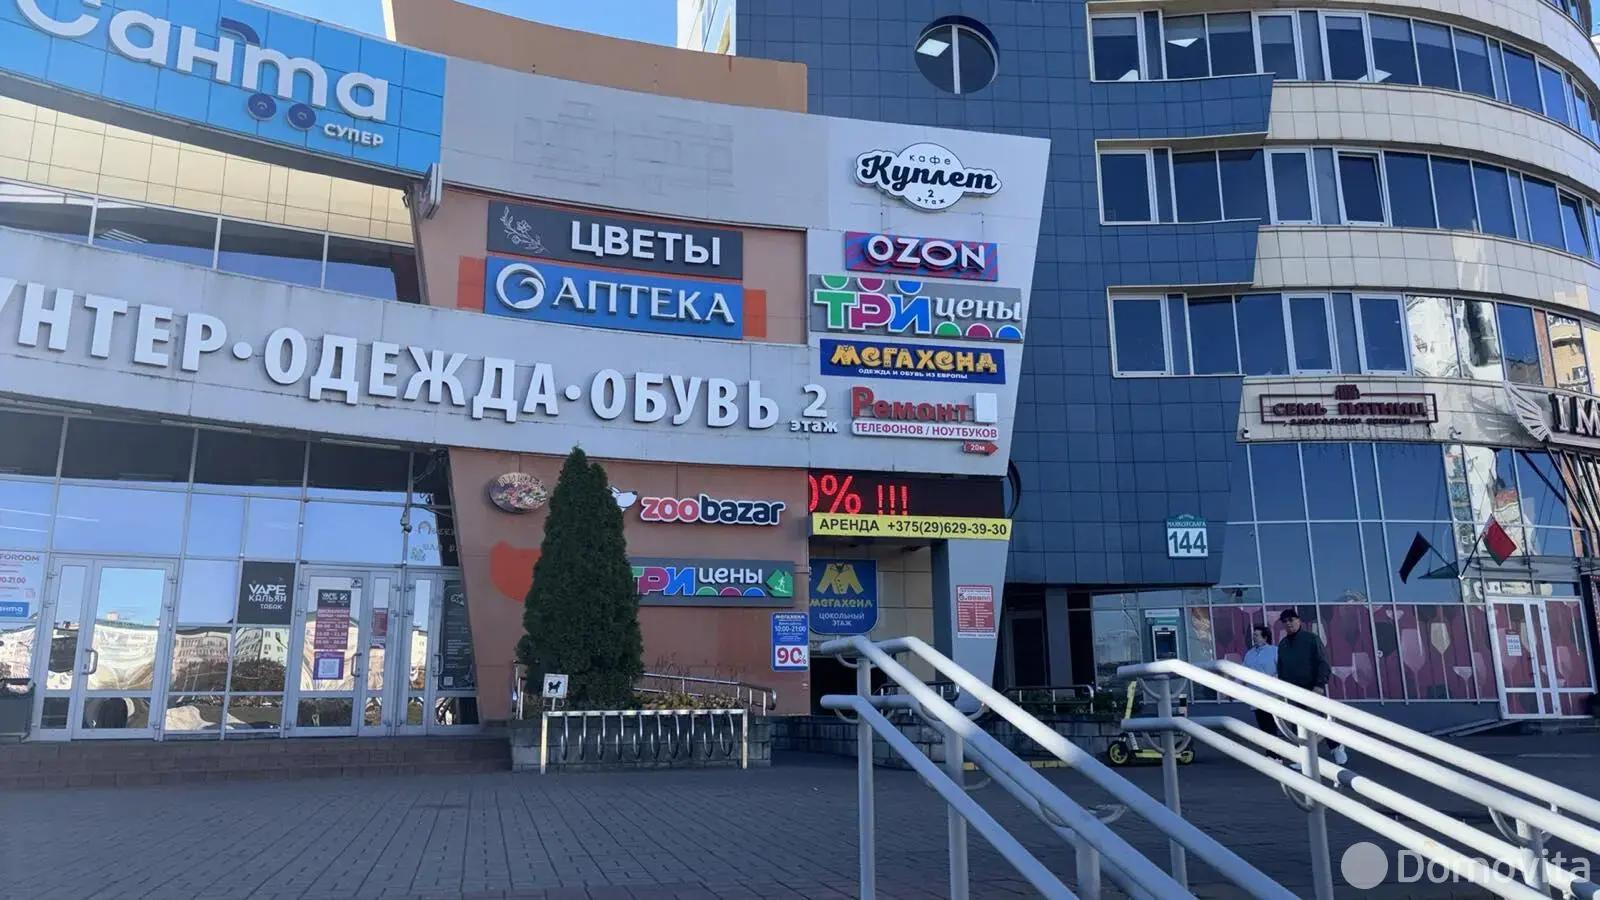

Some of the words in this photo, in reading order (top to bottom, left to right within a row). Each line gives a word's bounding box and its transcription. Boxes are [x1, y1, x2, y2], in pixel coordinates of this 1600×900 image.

[323, 122, 384, 148] СУПЕР
[909, 154, 951, 165] кафе
[861, 154, 998, 192] Куплет
[927, 189, 935, 198] 2
[571, 220, 721, 266] ЦВЕТЫ
[866, 235, 986, 271] OZON
[552, 277, 735, 324] АПТЕКА
[814, 288, 933, 335] ТРИ
[935, 297, 1022, 323] цены
[264, 326, 560, 423] ОДЕЖДА
[590, 368, 780, 430] ОБУВЬ
[858, 368, 891, 376] ОДЕЖДА
[936, 372, 968, 380] ЕВРОПЫ
[802, 383, 828, 419] 2
[851, 386, 970, 423] Ремонт
[1272, 402, 1328, 416] СЕМЬ
[1337, 402, 1428, 417] ПЯТНИЦ
[789, 419, 838, 434] этаж
[855, 422, 923, 435] ТЕЛЕФОНОВ
[932, 426, 998, 439] НОУТБУКОВ
[640, 493, 786, 525] zoobazar
[877, 484, 909, 516] !!!
[819, 518, 880, 533] АРЕНДА
[887, 520, 1007, 536] +375(29)629-39-30
[1169, 530, 1207, 554] 144
[699, 566, 763, 584] цены
[248, 583, 287, 595] VAPE
[248, 594, 287, 603] КАЛЬЯН
[818, 612, 865, 621] ЦОКОЛЬНЫЙ
